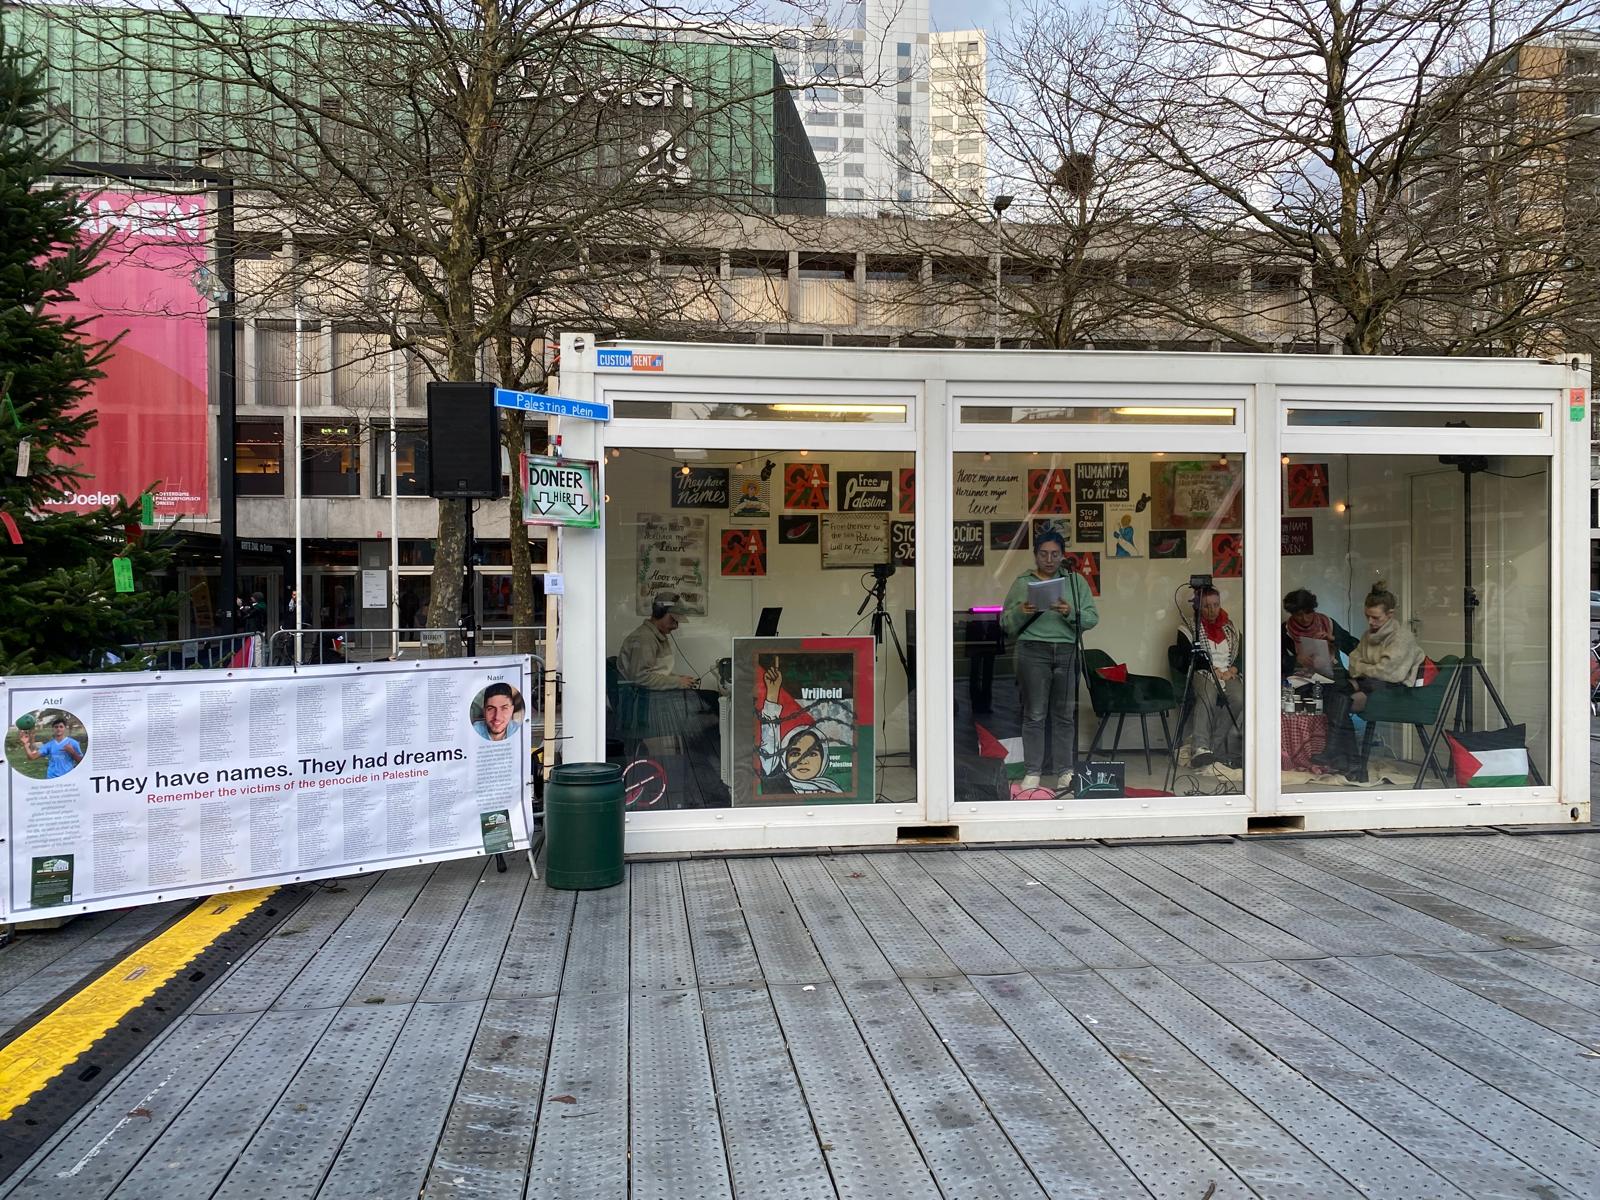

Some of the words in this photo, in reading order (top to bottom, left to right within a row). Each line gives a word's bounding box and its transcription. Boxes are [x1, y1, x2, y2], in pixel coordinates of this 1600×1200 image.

[600, 354, 631, 366] CUSTOM
[633, 355, 652, 366] RENT
[529, 467, 582, 489] DONEER
[858, 474, 878, 487] Free
[1080, 509, 1098, 517] STOP
[801, 687, 842, 699] Vrijheid
[43, 697, 63, 705] Atef
[89, 775, 148, 794] They
[155, 771, 209, 788] have
[216, 764, 293, 783] names.
[298, 758, 347, 775] They
[352, 752, 388, 770] had
[393, 748, 467, 766] dreams.
[147, 790, 215, 804] Remember
[218, 786, 237, 797] the
[240, 783, 280, 795] victims
[283, 780, 296, 790] of
[298, 779, 316, 789] the
[318, 774, 368, 789] genocide
[370, 773, 380, 782] in
[382, 769, 429, 780] Palestine
